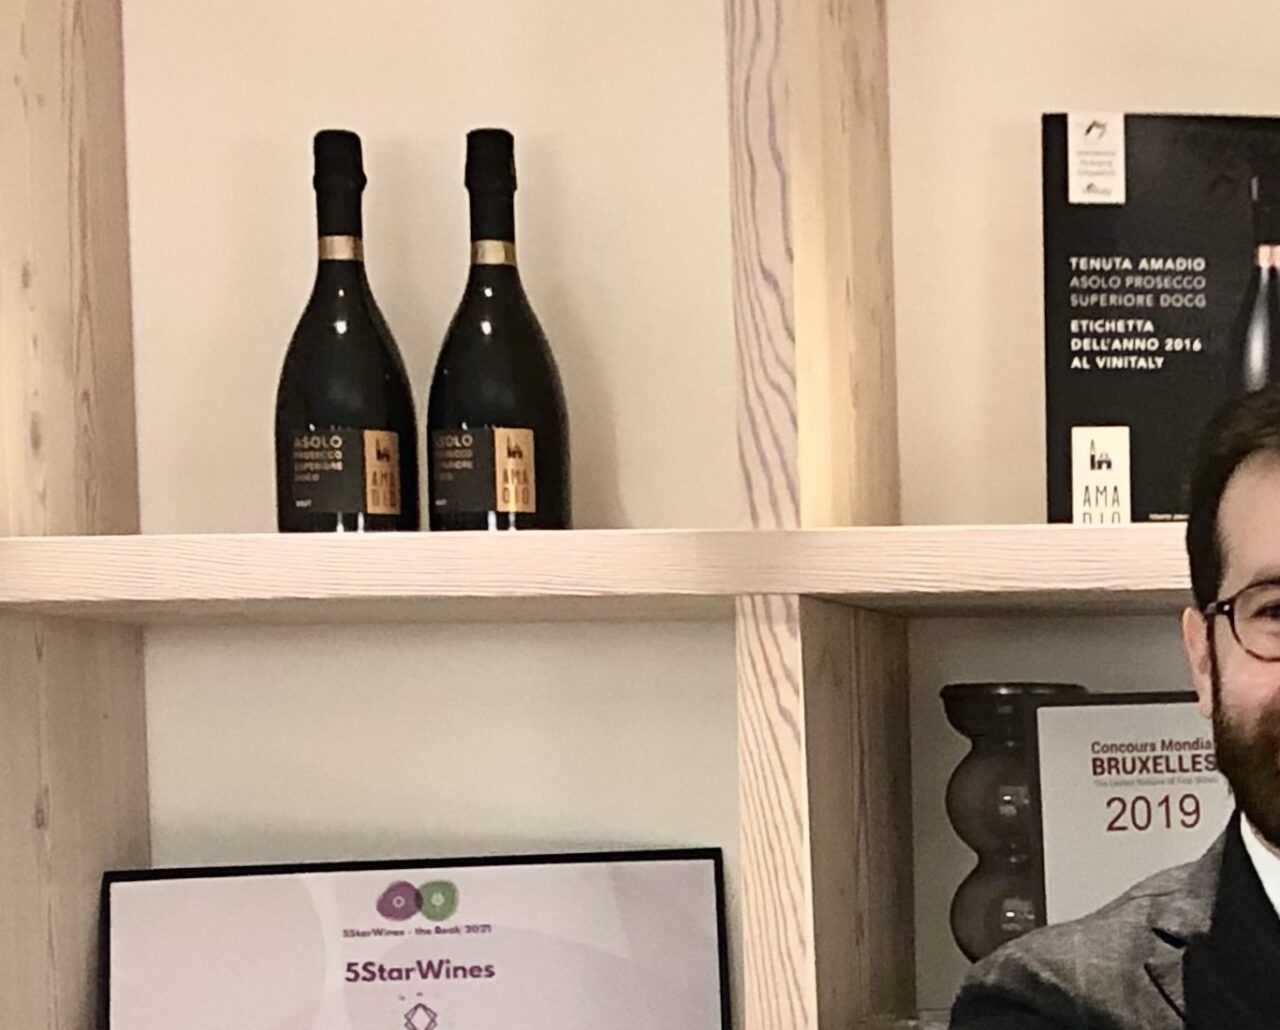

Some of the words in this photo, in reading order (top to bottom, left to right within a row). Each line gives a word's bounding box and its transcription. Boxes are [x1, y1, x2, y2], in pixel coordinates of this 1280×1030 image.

[1069, 257, 1132, 271] TENUTA
[1138, 257, 1206, 271] AMADIO
[1070, 275, 1121, 289] ASOLO
[1125, 275, 1206, 289] PROSECCO
[1070, 293, 1154, 307] SUPERIORE
[1159, 293, 1206, 308] DOCG
[1070, 319, 1154, 333] ETICHETTA
[1070, 337, 1160, 351] DELL'ANNO
[1164, 338, 1202, 351] 2016
[1070, 356, 1090, 369] AL
[1095, 356, 1164, 369] VINITALY
[294, 435, 343, 449] ASOLO
[1083, 485, 1120, 507] AMA
[1091, 741, 1157, 754] Concours
[1092, 754, 1217, 776] BRUXELLES
[1106, 793, 1201, 831] 2019
[415, 927, 432, 936] the
[435, 926, 460, 935] Book
[345, 959, 495, 982] 5StarWines
